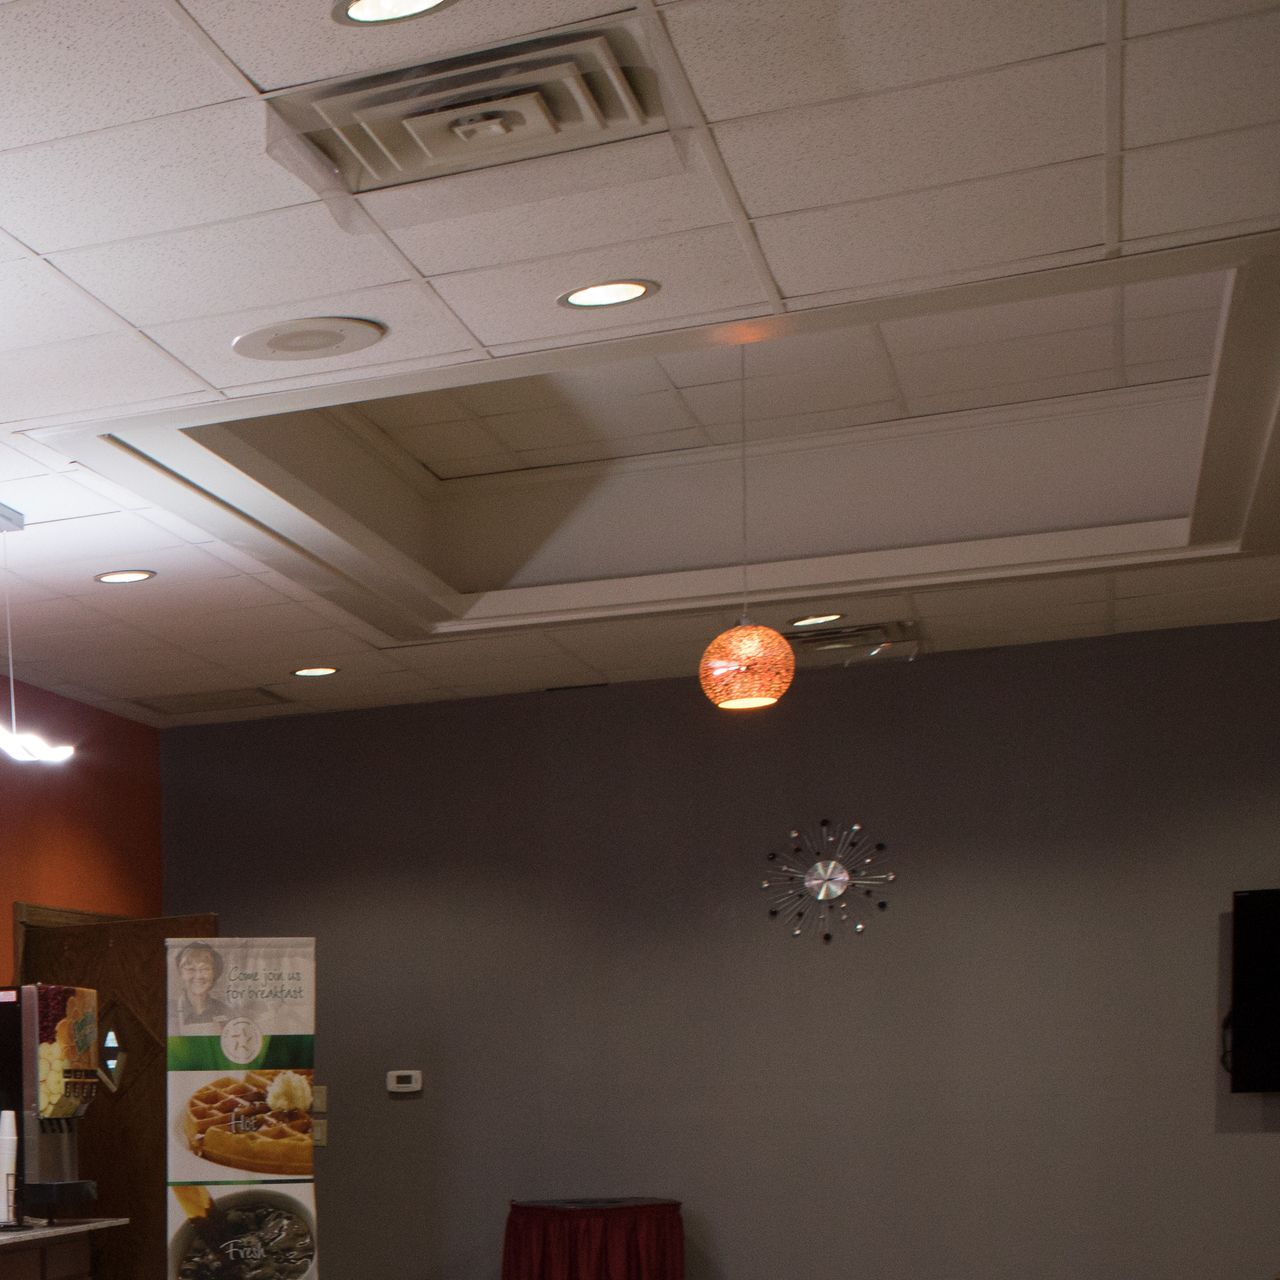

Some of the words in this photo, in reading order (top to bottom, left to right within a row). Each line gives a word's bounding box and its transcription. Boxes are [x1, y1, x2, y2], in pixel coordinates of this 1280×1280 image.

[228, 966, 259, 982] Come
[262, 968, 284, 987] join
[287, 971, 303, 982] us
[225, 984, 248, 1003] for
[248, 984, 304, 1003] breakfast
[228, 1108, 258, 1134] Hot
[219, 1239, 267, 1260] Fresh
